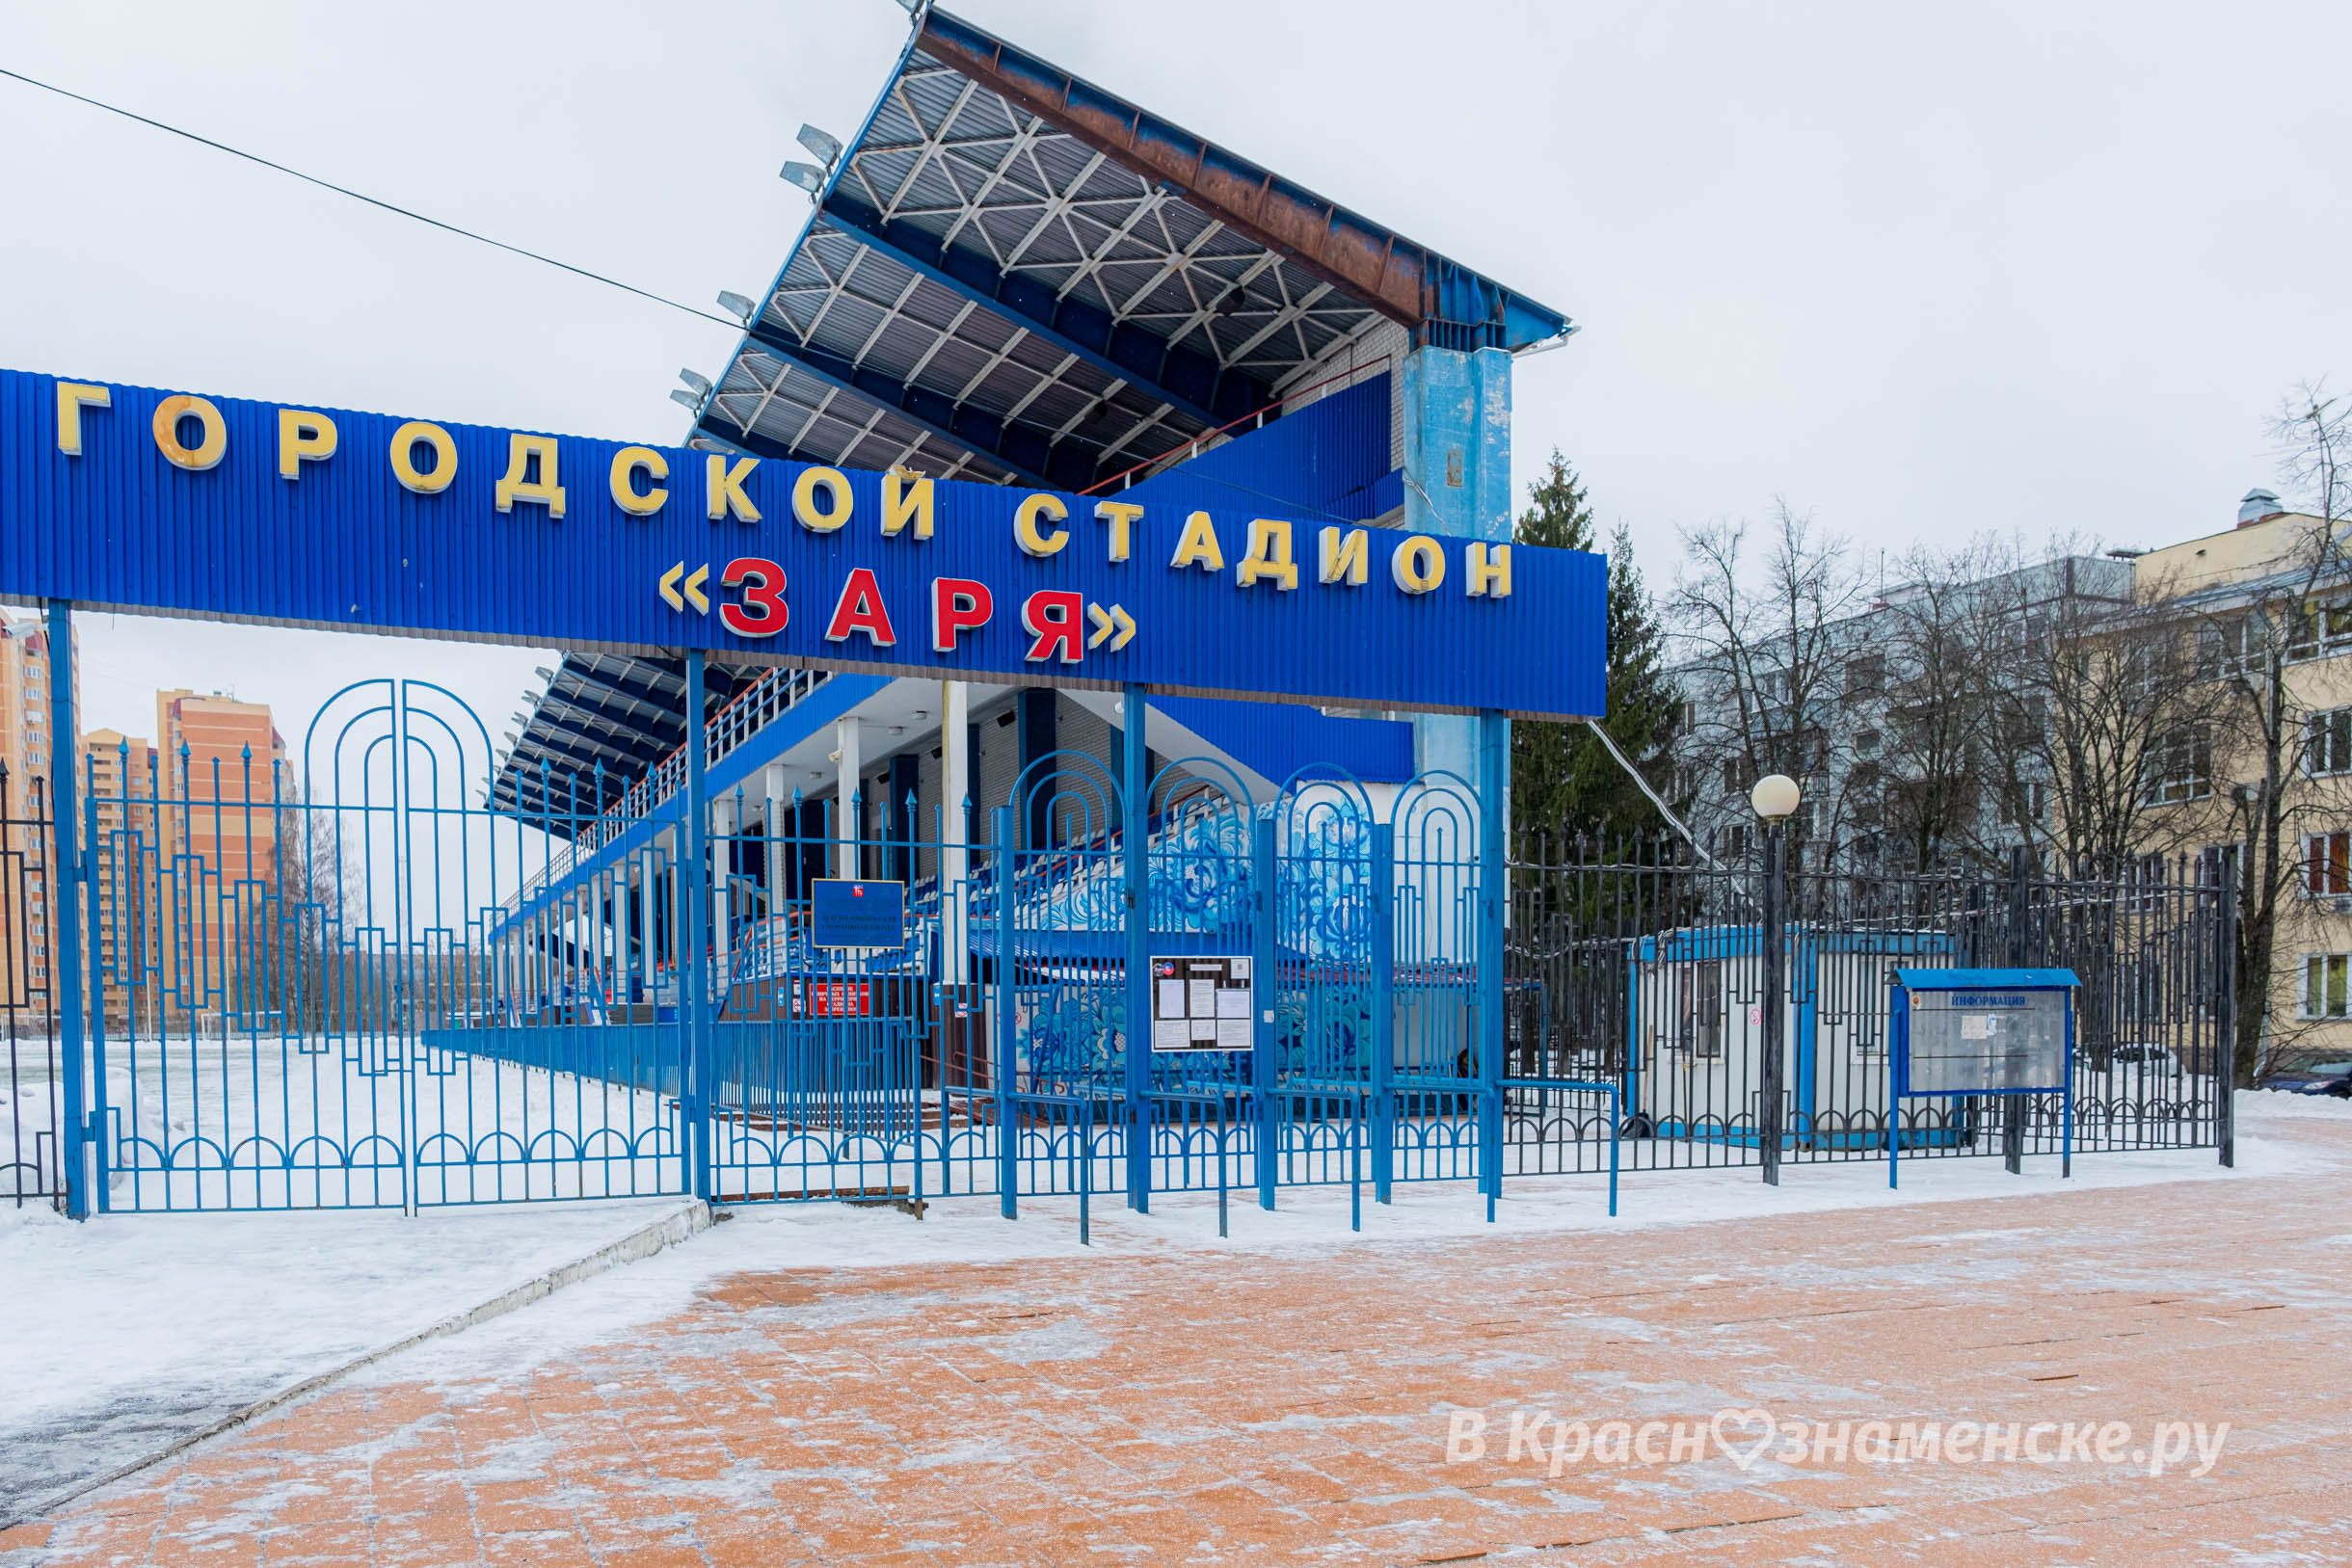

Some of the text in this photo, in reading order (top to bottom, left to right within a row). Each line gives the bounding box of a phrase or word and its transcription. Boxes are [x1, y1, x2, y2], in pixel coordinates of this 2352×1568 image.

[56, 382, 1511, 598] ГОРОДСКОЙ СТАДИОН
[658, 556, 1137, 664] «ЗАРЯ»
[1951, 996, 2026, 1006] ИНФОРМАЦИЯ
